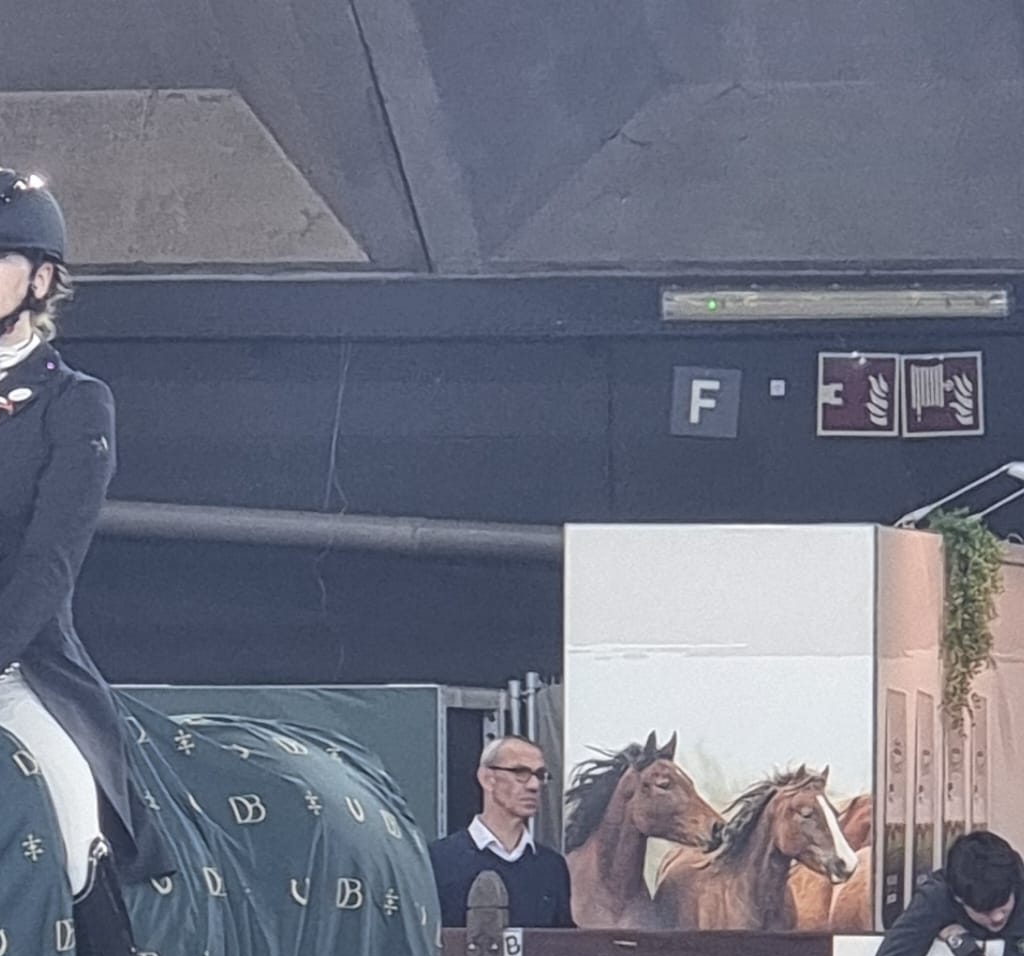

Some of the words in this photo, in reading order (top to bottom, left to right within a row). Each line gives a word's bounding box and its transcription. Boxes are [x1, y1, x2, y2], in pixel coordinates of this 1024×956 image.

[689, 379, 720, 424] F
[12, 750, 42, 777] D
[228, 794, 266, 824] DB
[336, 877, 363, 910] DB
[505, 935, 520, 956] B
